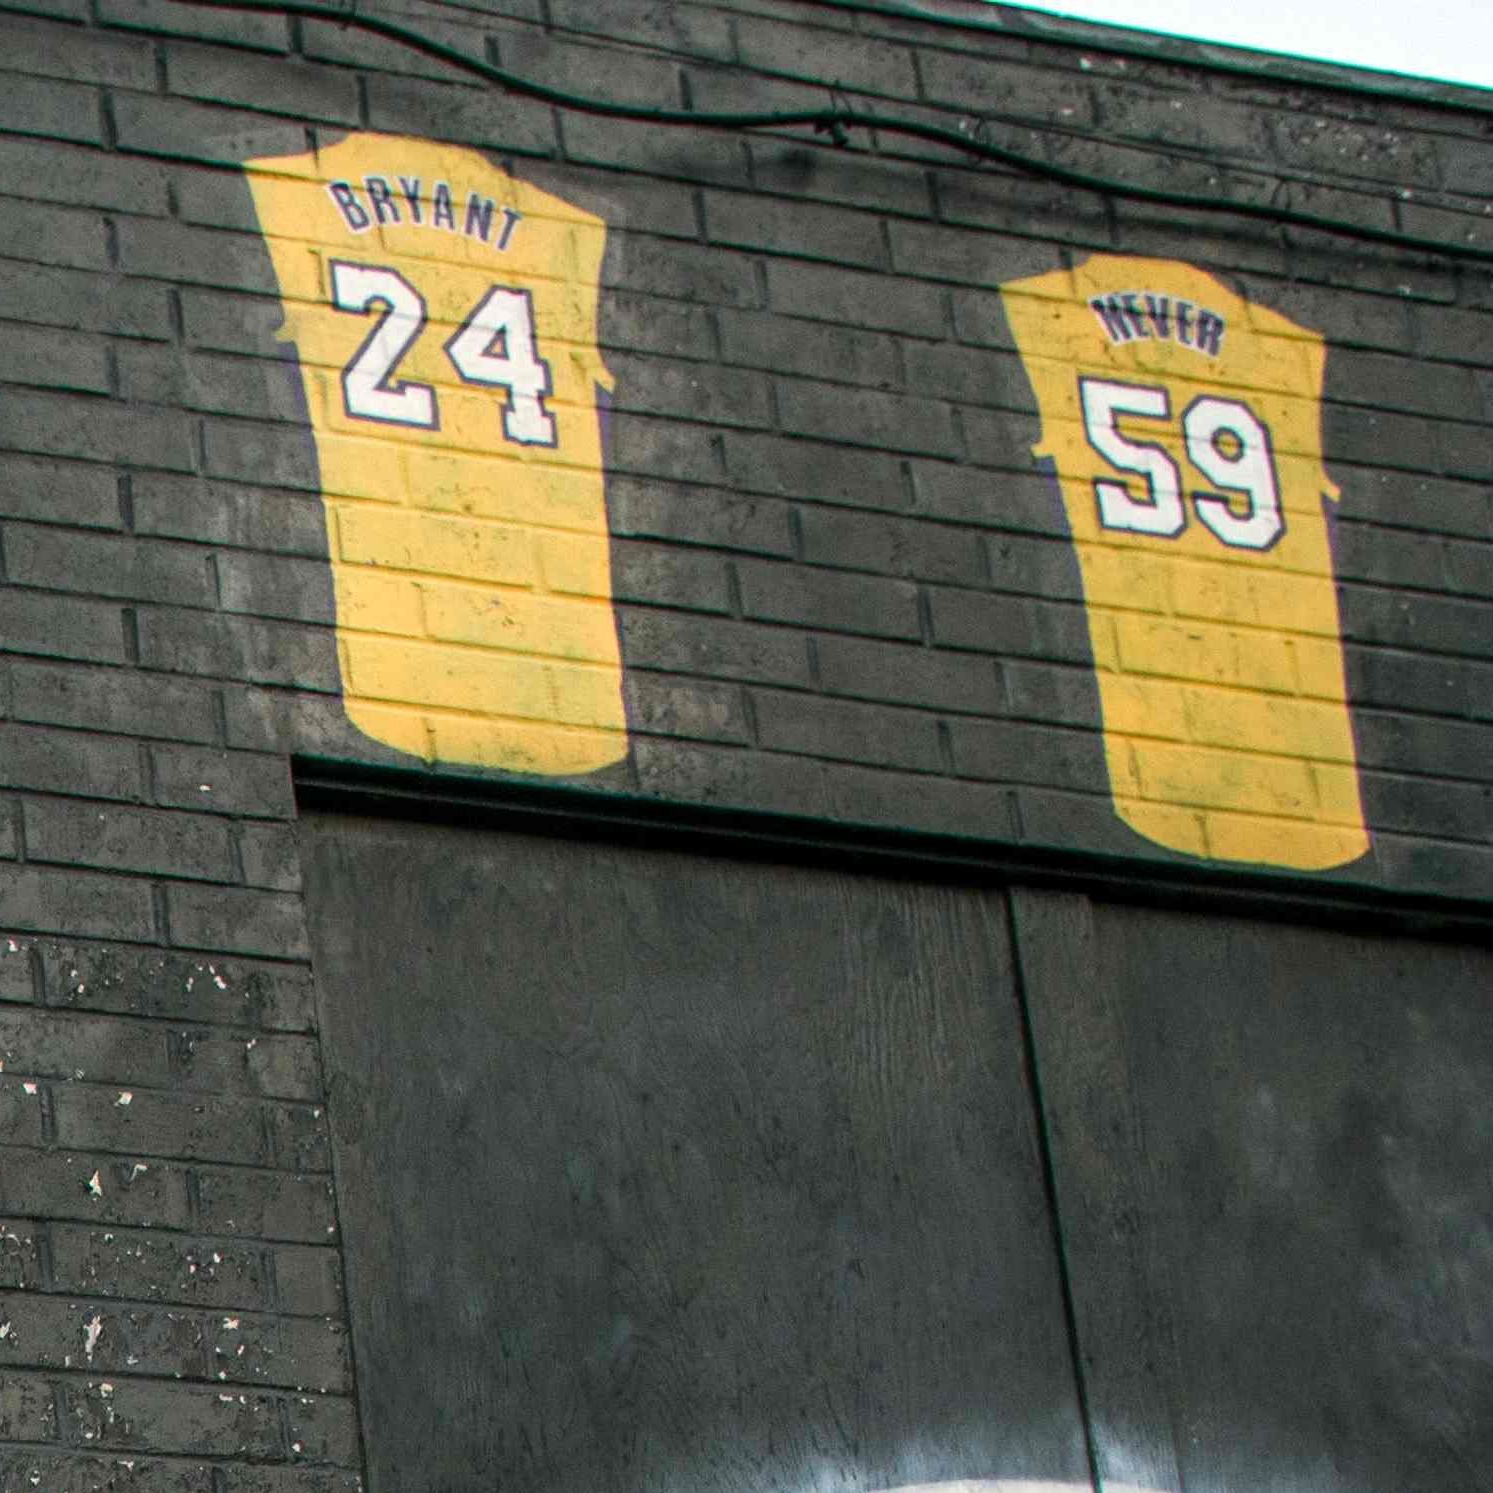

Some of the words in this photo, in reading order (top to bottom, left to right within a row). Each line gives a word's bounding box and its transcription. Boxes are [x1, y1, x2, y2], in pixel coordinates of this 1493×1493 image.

[326, 174, 526, 254] BRYANT
[328, 257, 560, 451] 24
[1087, 289, 1227, 362] NEVER
[1076, 374, 1288, 555] 59
